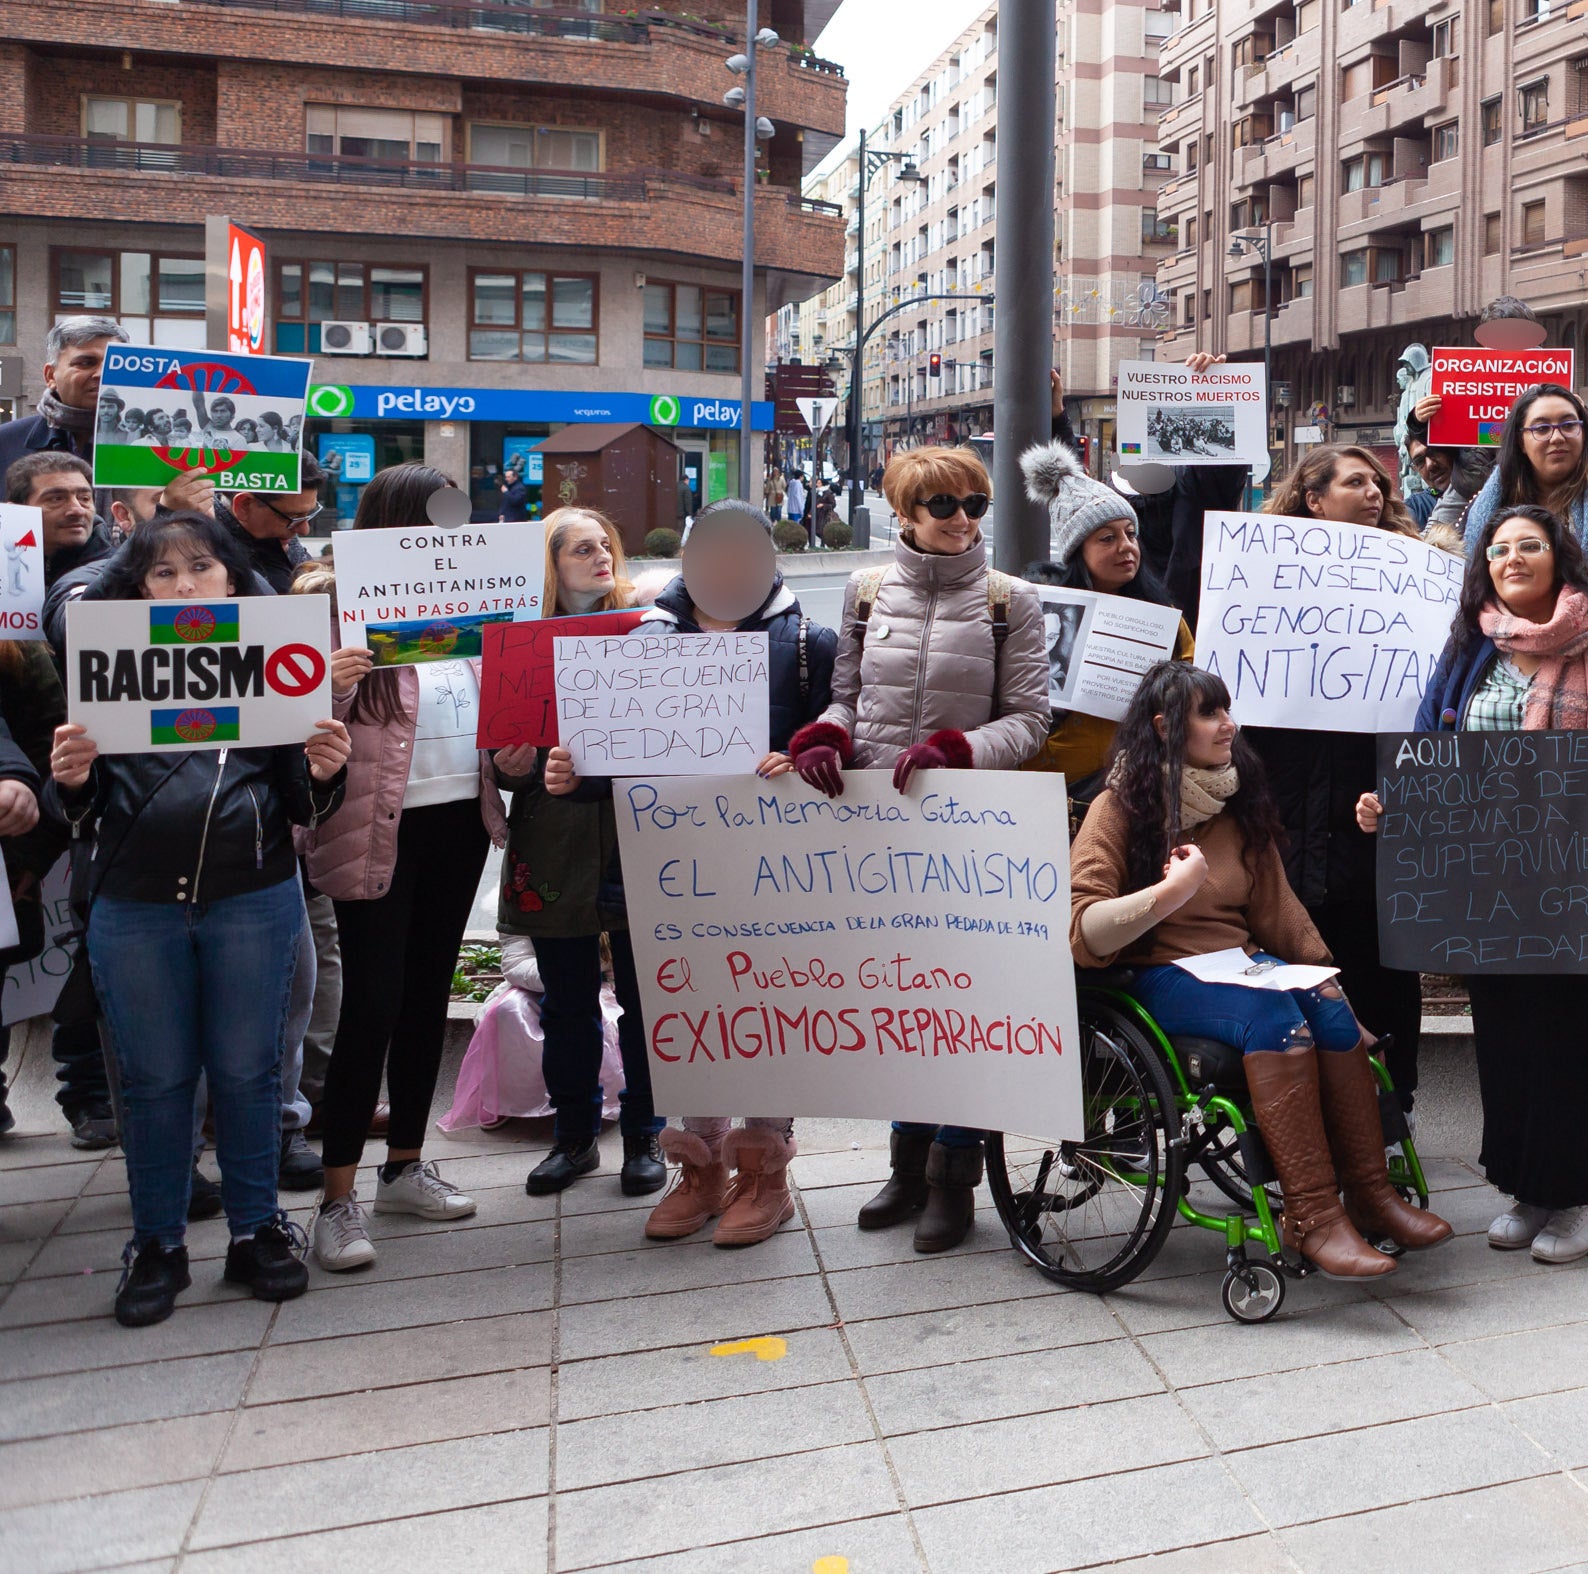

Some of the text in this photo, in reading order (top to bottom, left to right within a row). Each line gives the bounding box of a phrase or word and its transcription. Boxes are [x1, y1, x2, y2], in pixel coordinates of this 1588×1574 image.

[109, 354, 181, 374] DOSTA
[1127, 372, 1251, 385] VUESTRO RACISMO
[1434, 357, 1568, 374] ORGANIZACIÓN
[1122, 390, 1260, 402] NUESTROS MUERTOS
[1442, 381, 1532, 396] RESISTEN
[378, 389, 476, 418] pelayo
[693, 400, 743, 427] pelay
[1468, 405, 1513, 420] LUCH
[220, 471, 288, 488] BASTA
[400, 533, 488, 550] CONTRA
[1218, 521, 1408, 565] MARQUES
[435, 559, 459, 571] EL
[358, 574, 528, 599] ANTIGITANISMO
[1207, 563, 1460, 607] LA ENSENADA
[343, 594, 539, 623] NI UN PASO ATRÁS
[1222, 604, 1413, 635] GENOCIDA
[559, 636, 765, 661] LA POBREZA ES
[557, 659, 769, 691] CONSECUENCIA
[561, 693, 746, 720] DE LA GRAN
[567, 727, 755, 761] REDADA
[1395, 735, 1460, 769] AQUI
[1482, 736, 1537, 768] NOS
[1383, 766, 1520, 806] MARQUÉS
[1535, 769, 1587, 798] DE
[628, 784, 1017, 832] Por la Memoria Gitana
[1383, 803, 1569, 838] ENSENADA
[658, 845, 1058, 902] EL ANTIGITANISMO
[1387, 889, 1448, 924] DE
[1466, 890, 1520, 923] LA
[654, 922, 682, 941] ES
[692, 919, 836, 940] CONSECUENCIA
[846, 917, 869, 930] DE
[891, 913, 939, 929] GRAN
[997, 921, 1013, 934] DE
[1017, 921, 1048, 940] 1749
[657, 951, 972, 993] El Pueblo Gitano
[652, 1001, 1063, 1063] EXIGIMOS REPARACIÓN
